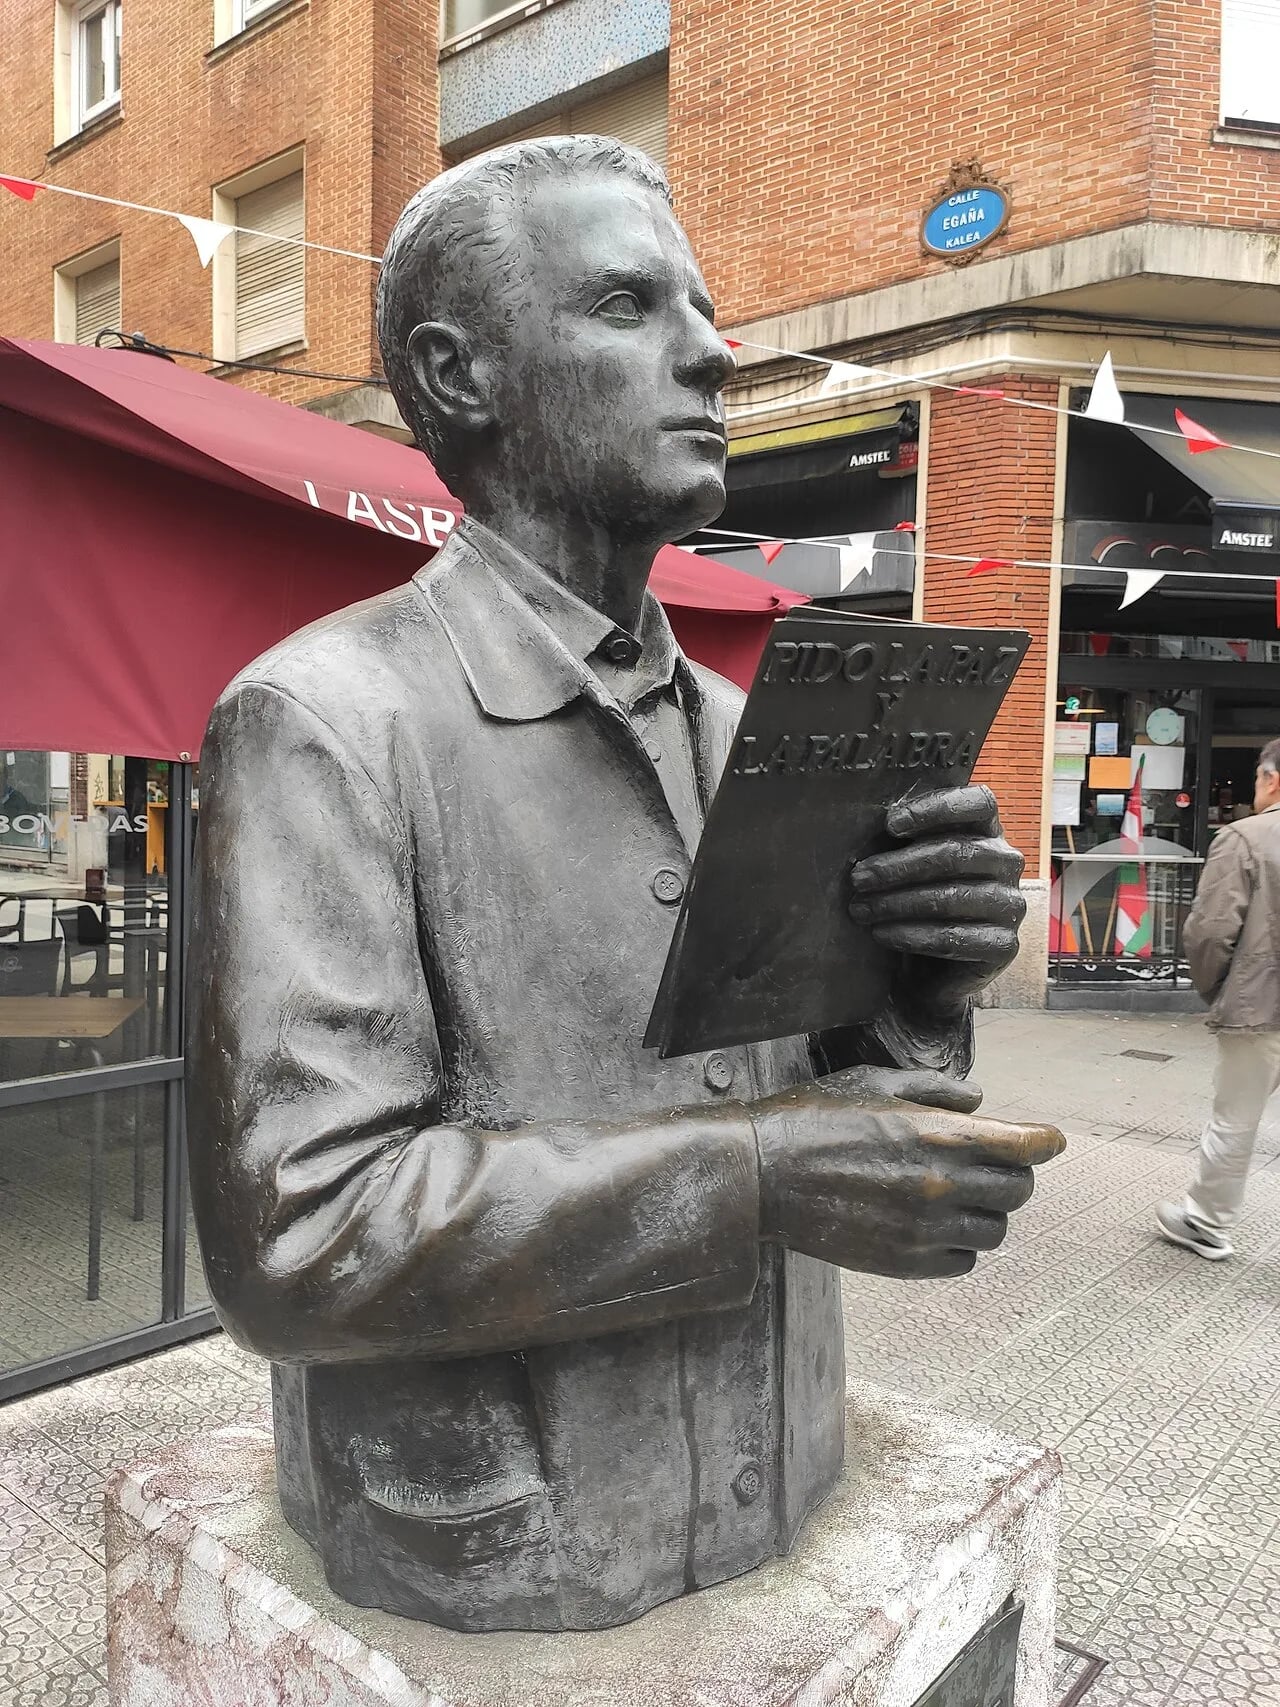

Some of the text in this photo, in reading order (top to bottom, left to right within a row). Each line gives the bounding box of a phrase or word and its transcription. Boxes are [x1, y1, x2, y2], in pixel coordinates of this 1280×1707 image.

[948, 190, 980, 207] CALLE
[943, 207, 985, 231] EGAÑA
[946, 231, 980, 248] KALEA
[849, 450, 891, 467] AMSTEL
[1219, 529, 1274, 548] AMSTEL
[761, 641, 1019, 685] PIDO LA PAZ
[871, 692, 902, 731] Y
[733, 731, 976, 775] LA PALABRA
